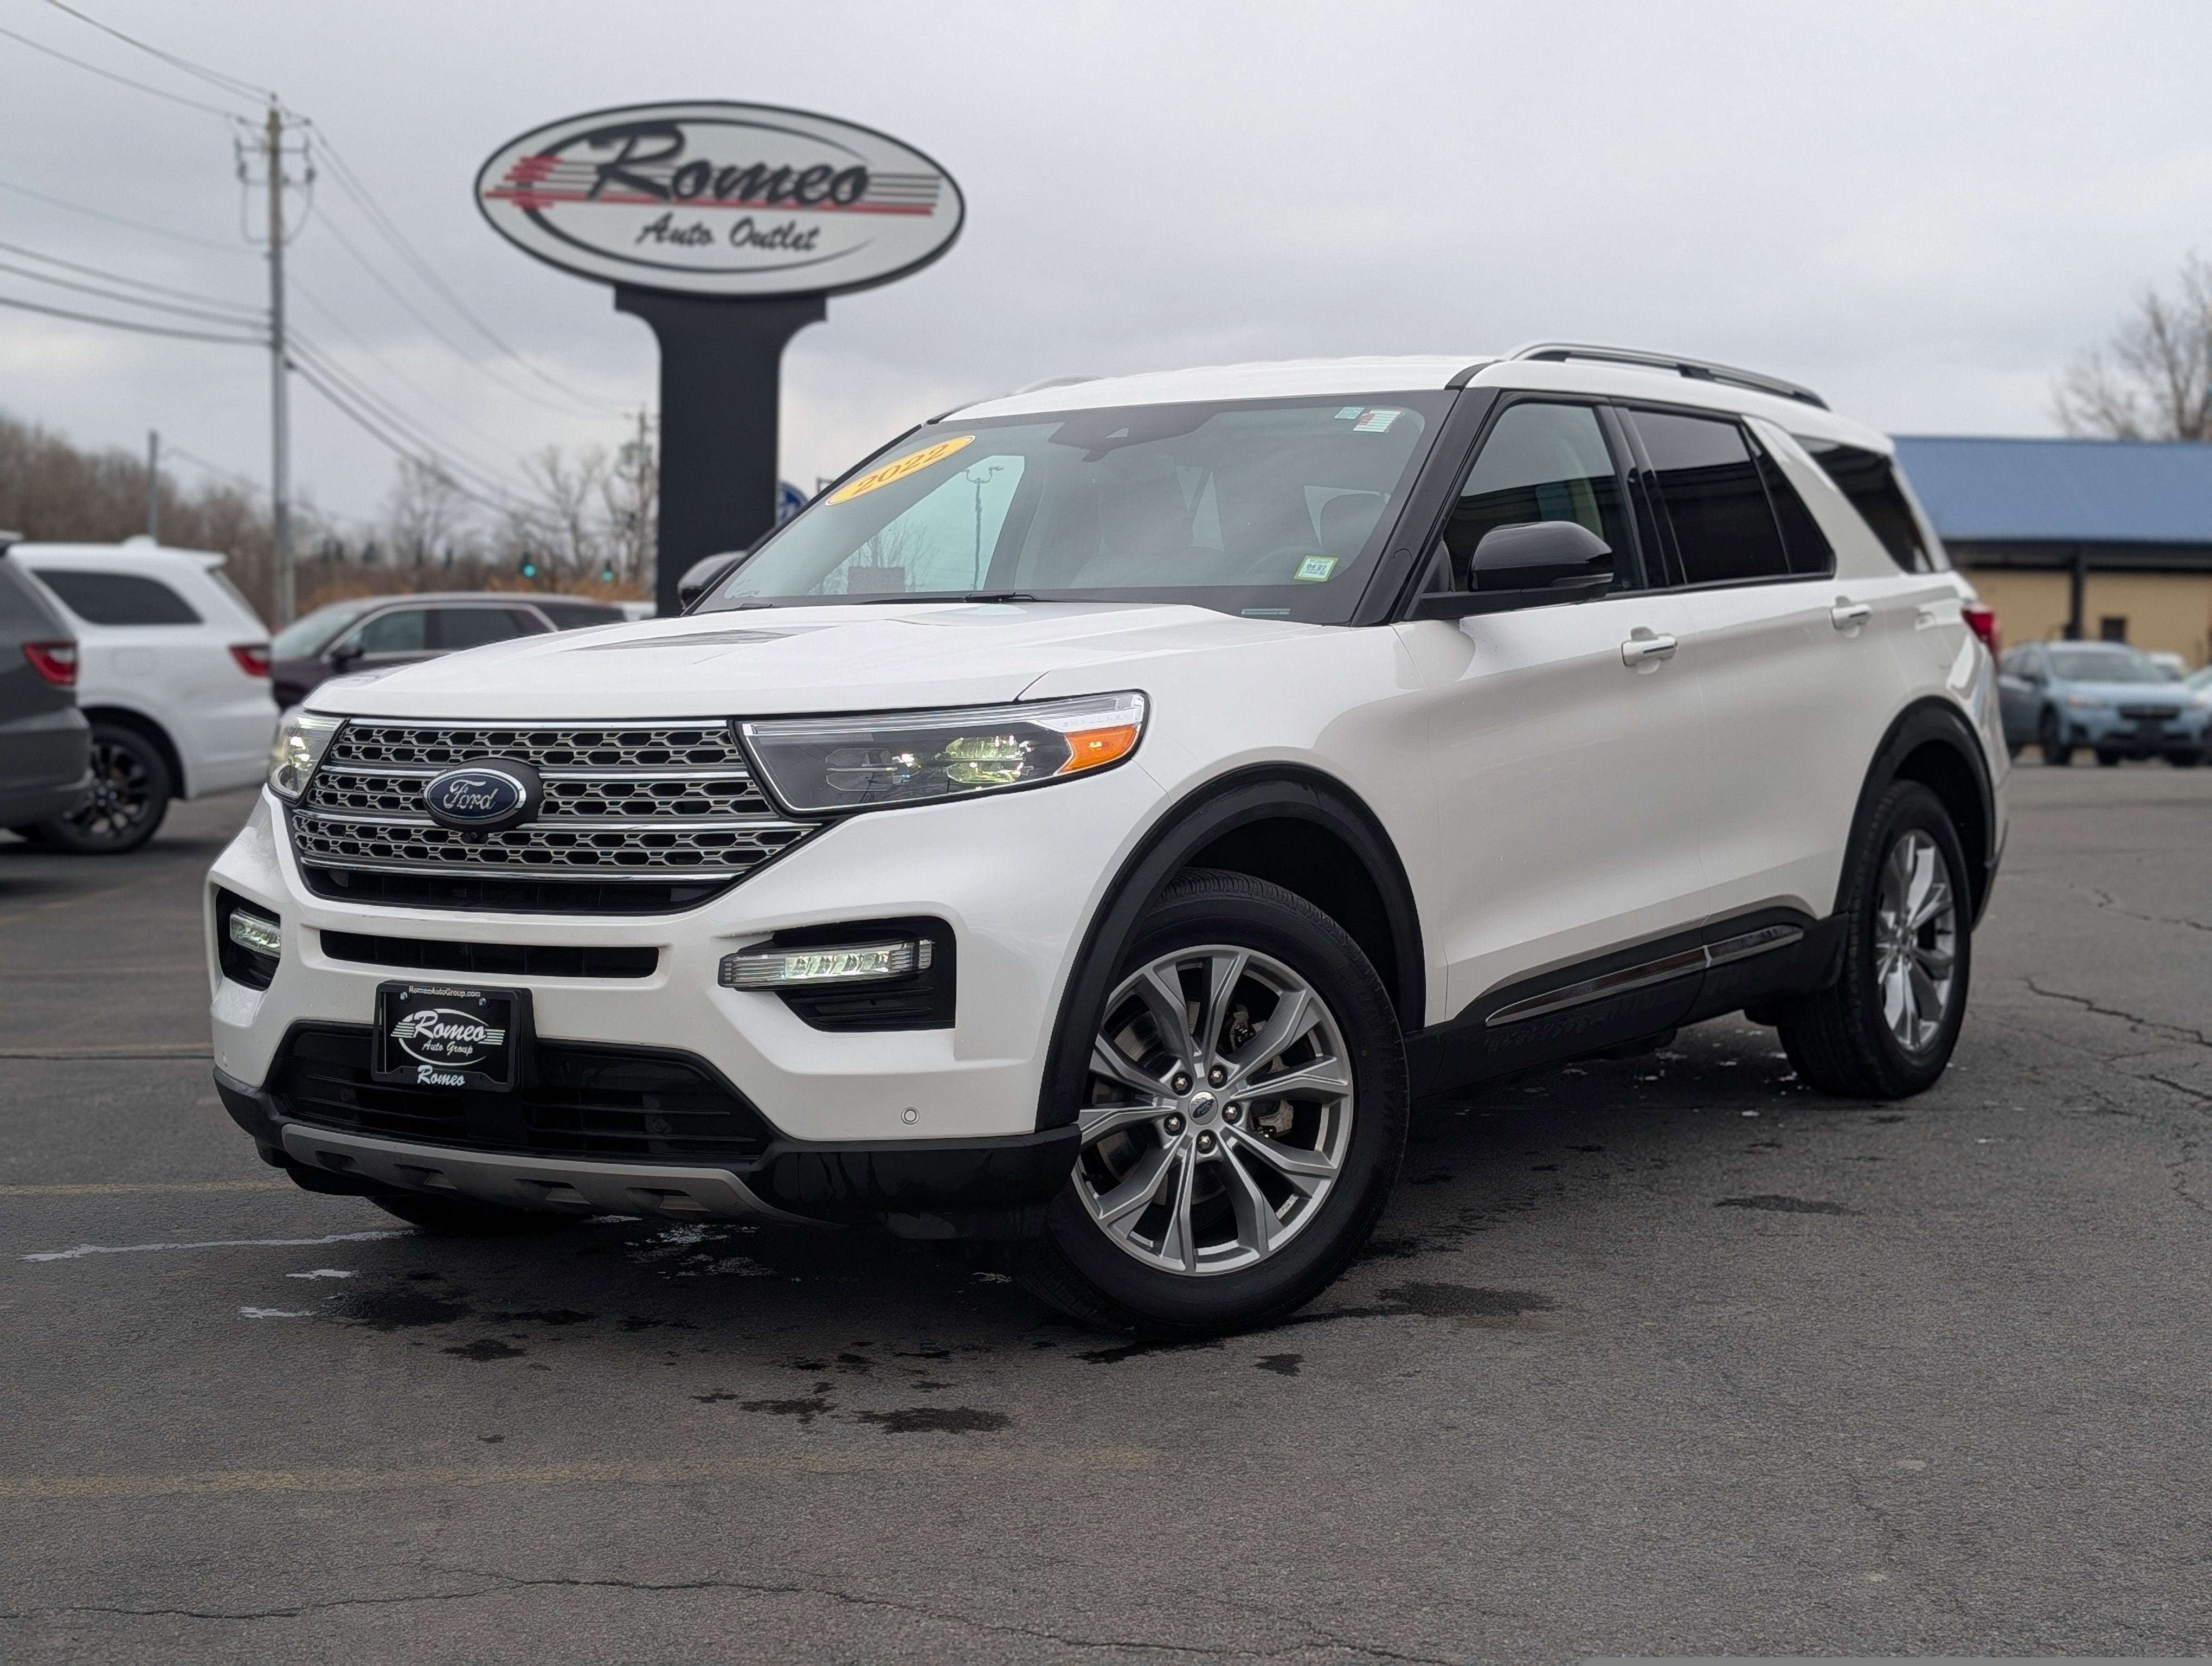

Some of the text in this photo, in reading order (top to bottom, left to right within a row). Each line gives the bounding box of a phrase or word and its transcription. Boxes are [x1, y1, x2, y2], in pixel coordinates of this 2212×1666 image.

[586, 123, 870, 206] Romeo
[635, 213, 821, 251] Auto Outlet
[851, 444, 949, 497] 2022
[443, 779, 499, 810] Ford
[413, 1010, 486, 1041] Romeo
[421, 1039, 473, 1056] Auto Group
[417, 1065, 465, 1086] Romeo
